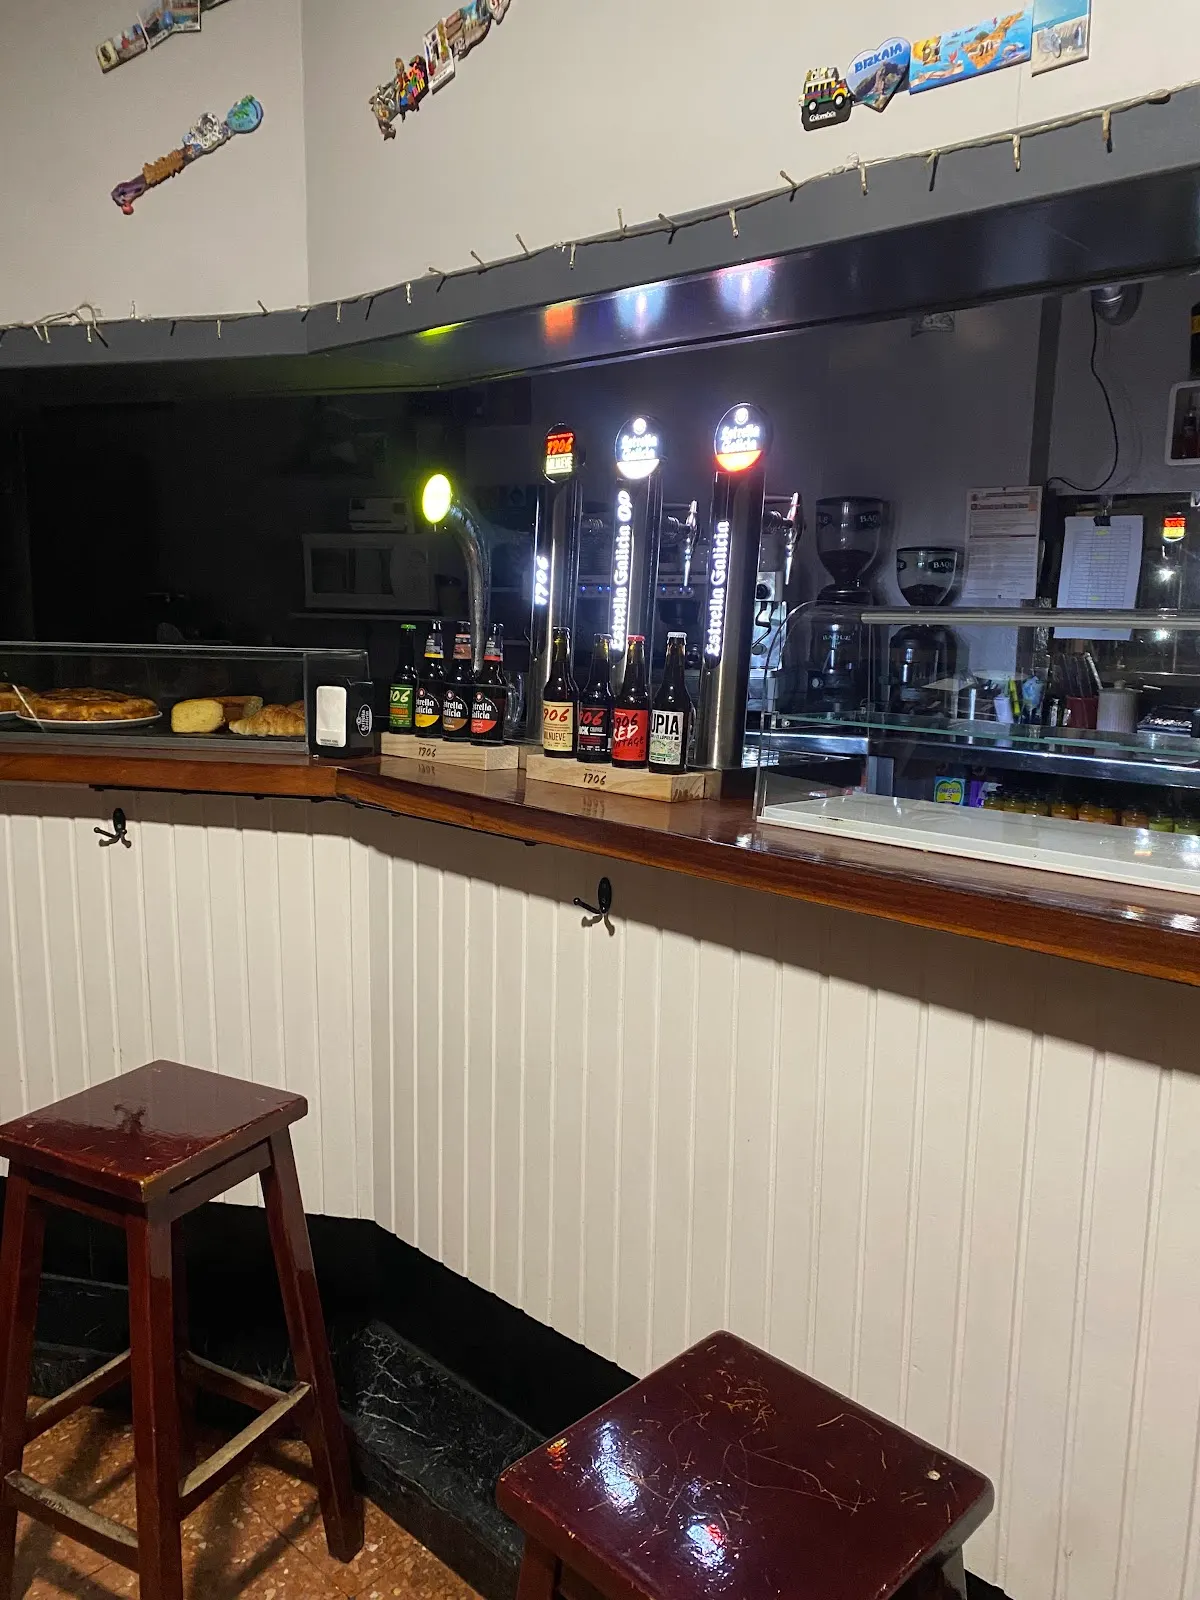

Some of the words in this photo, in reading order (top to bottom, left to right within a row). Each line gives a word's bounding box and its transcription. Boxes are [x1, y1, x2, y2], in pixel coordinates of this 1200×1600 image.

[855, 43, 902, 73] BIZKAIA
[547, 437, 573, 454] 1906
[614, 525, 630, 585] Galicia
[711, 521, 729, 586] Galicia
[535, 555, 550, 605] 1906
[611, 587, 628, 652] Estrella
[705, 587, 725, 657] Estrella
[419, 747, 437, 758] 1906
[583, 773, 607, 785] 1906
